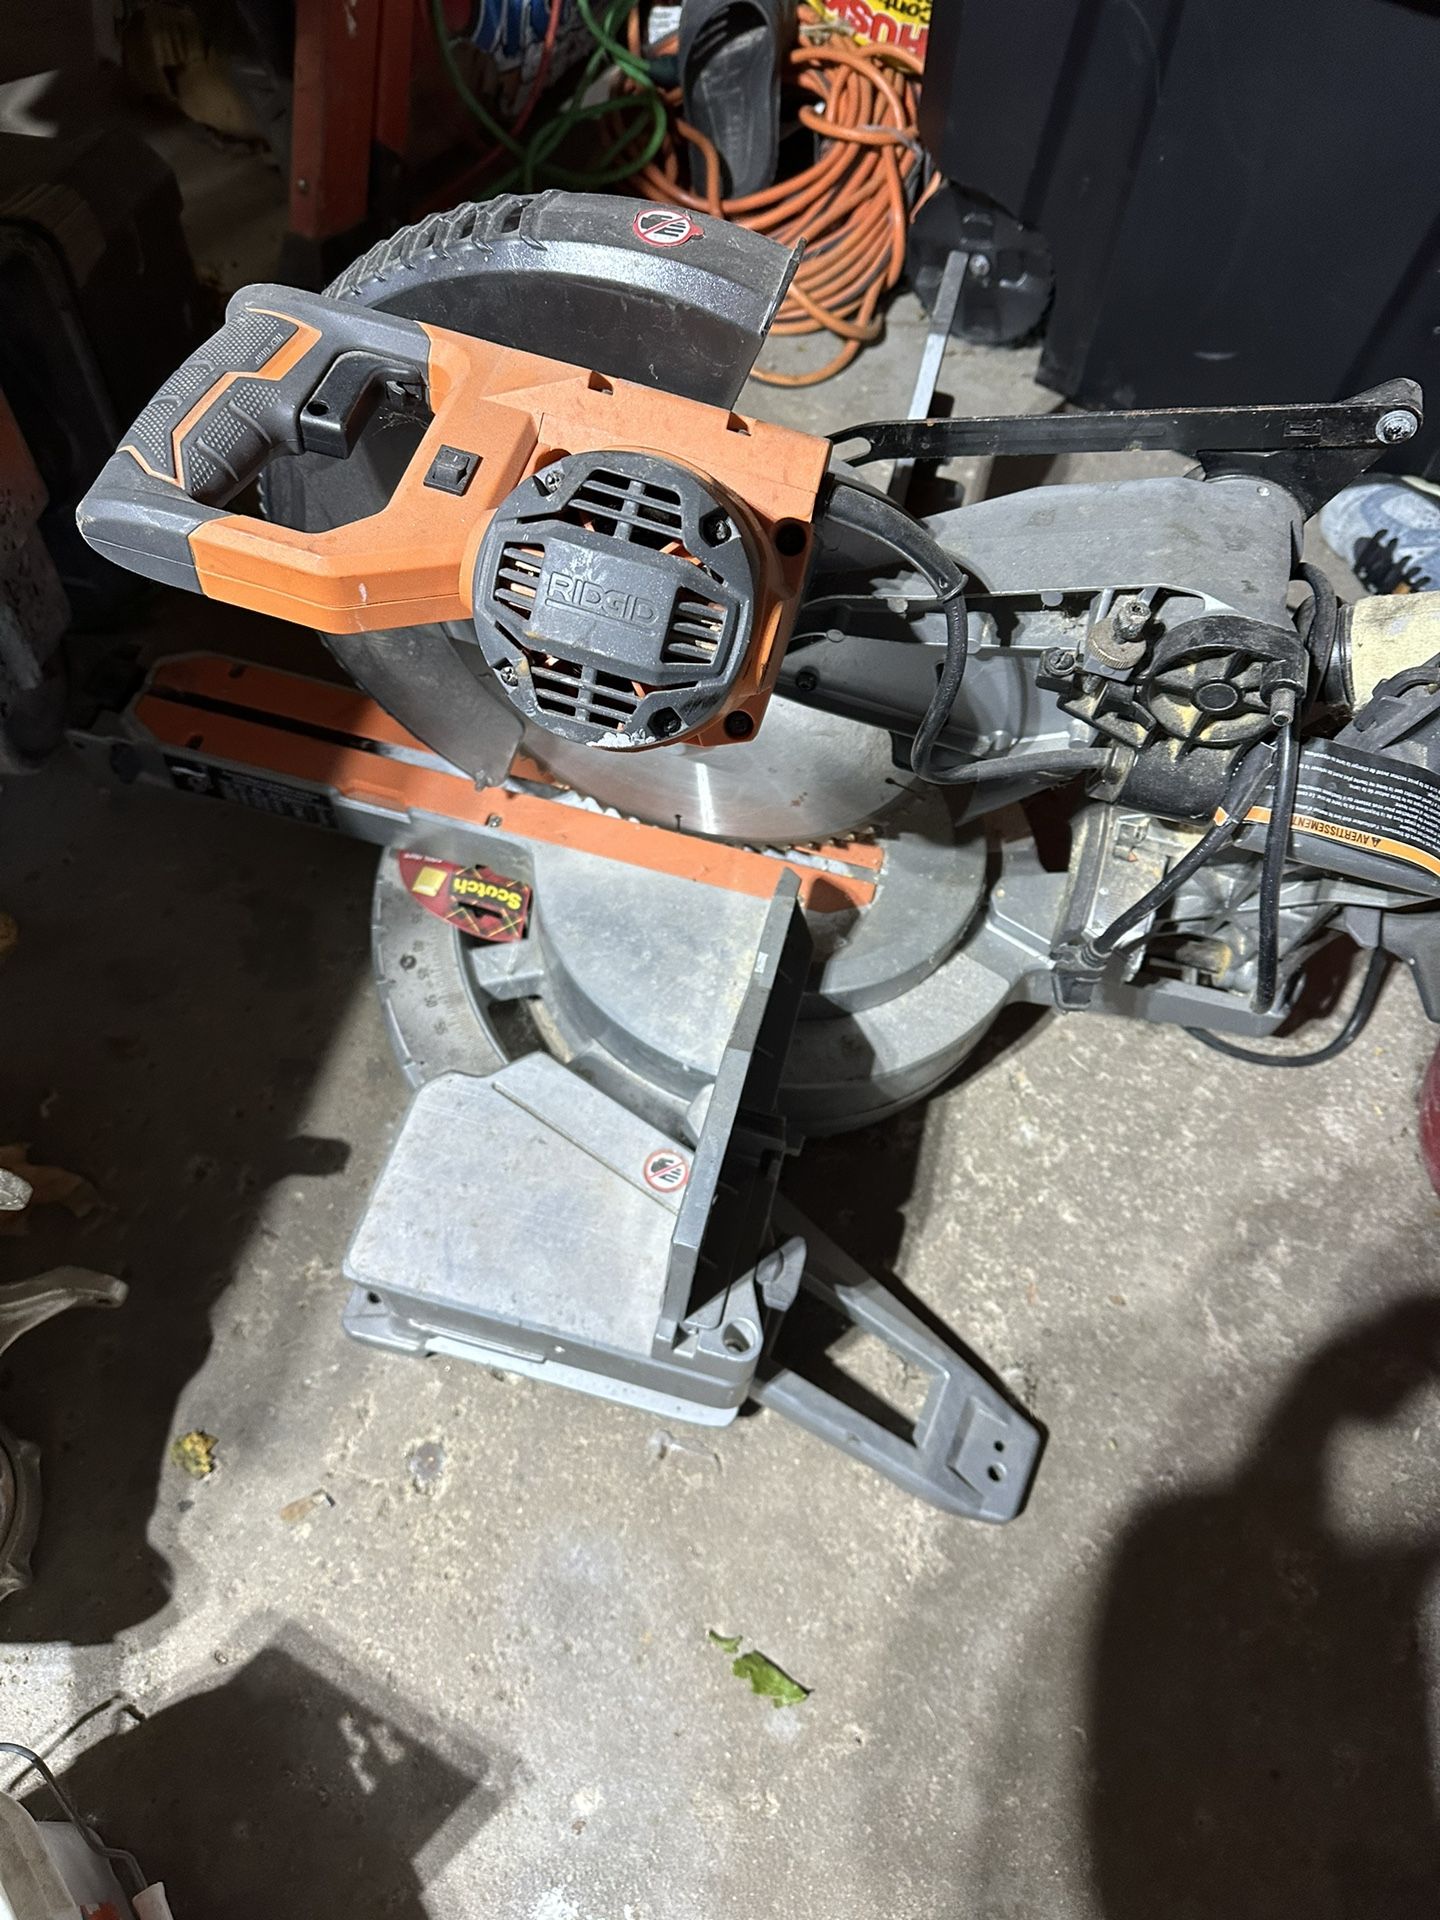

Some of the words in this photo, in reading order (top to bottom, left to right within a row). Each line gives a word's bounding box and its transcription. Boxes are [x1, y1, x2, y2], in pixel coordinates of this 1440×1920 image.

[547, 571, 659, 625] RIDGID
[1291, 816, 1370, 845] AVERTISSEMENT
[453, 878, 522, 910] Scotch
